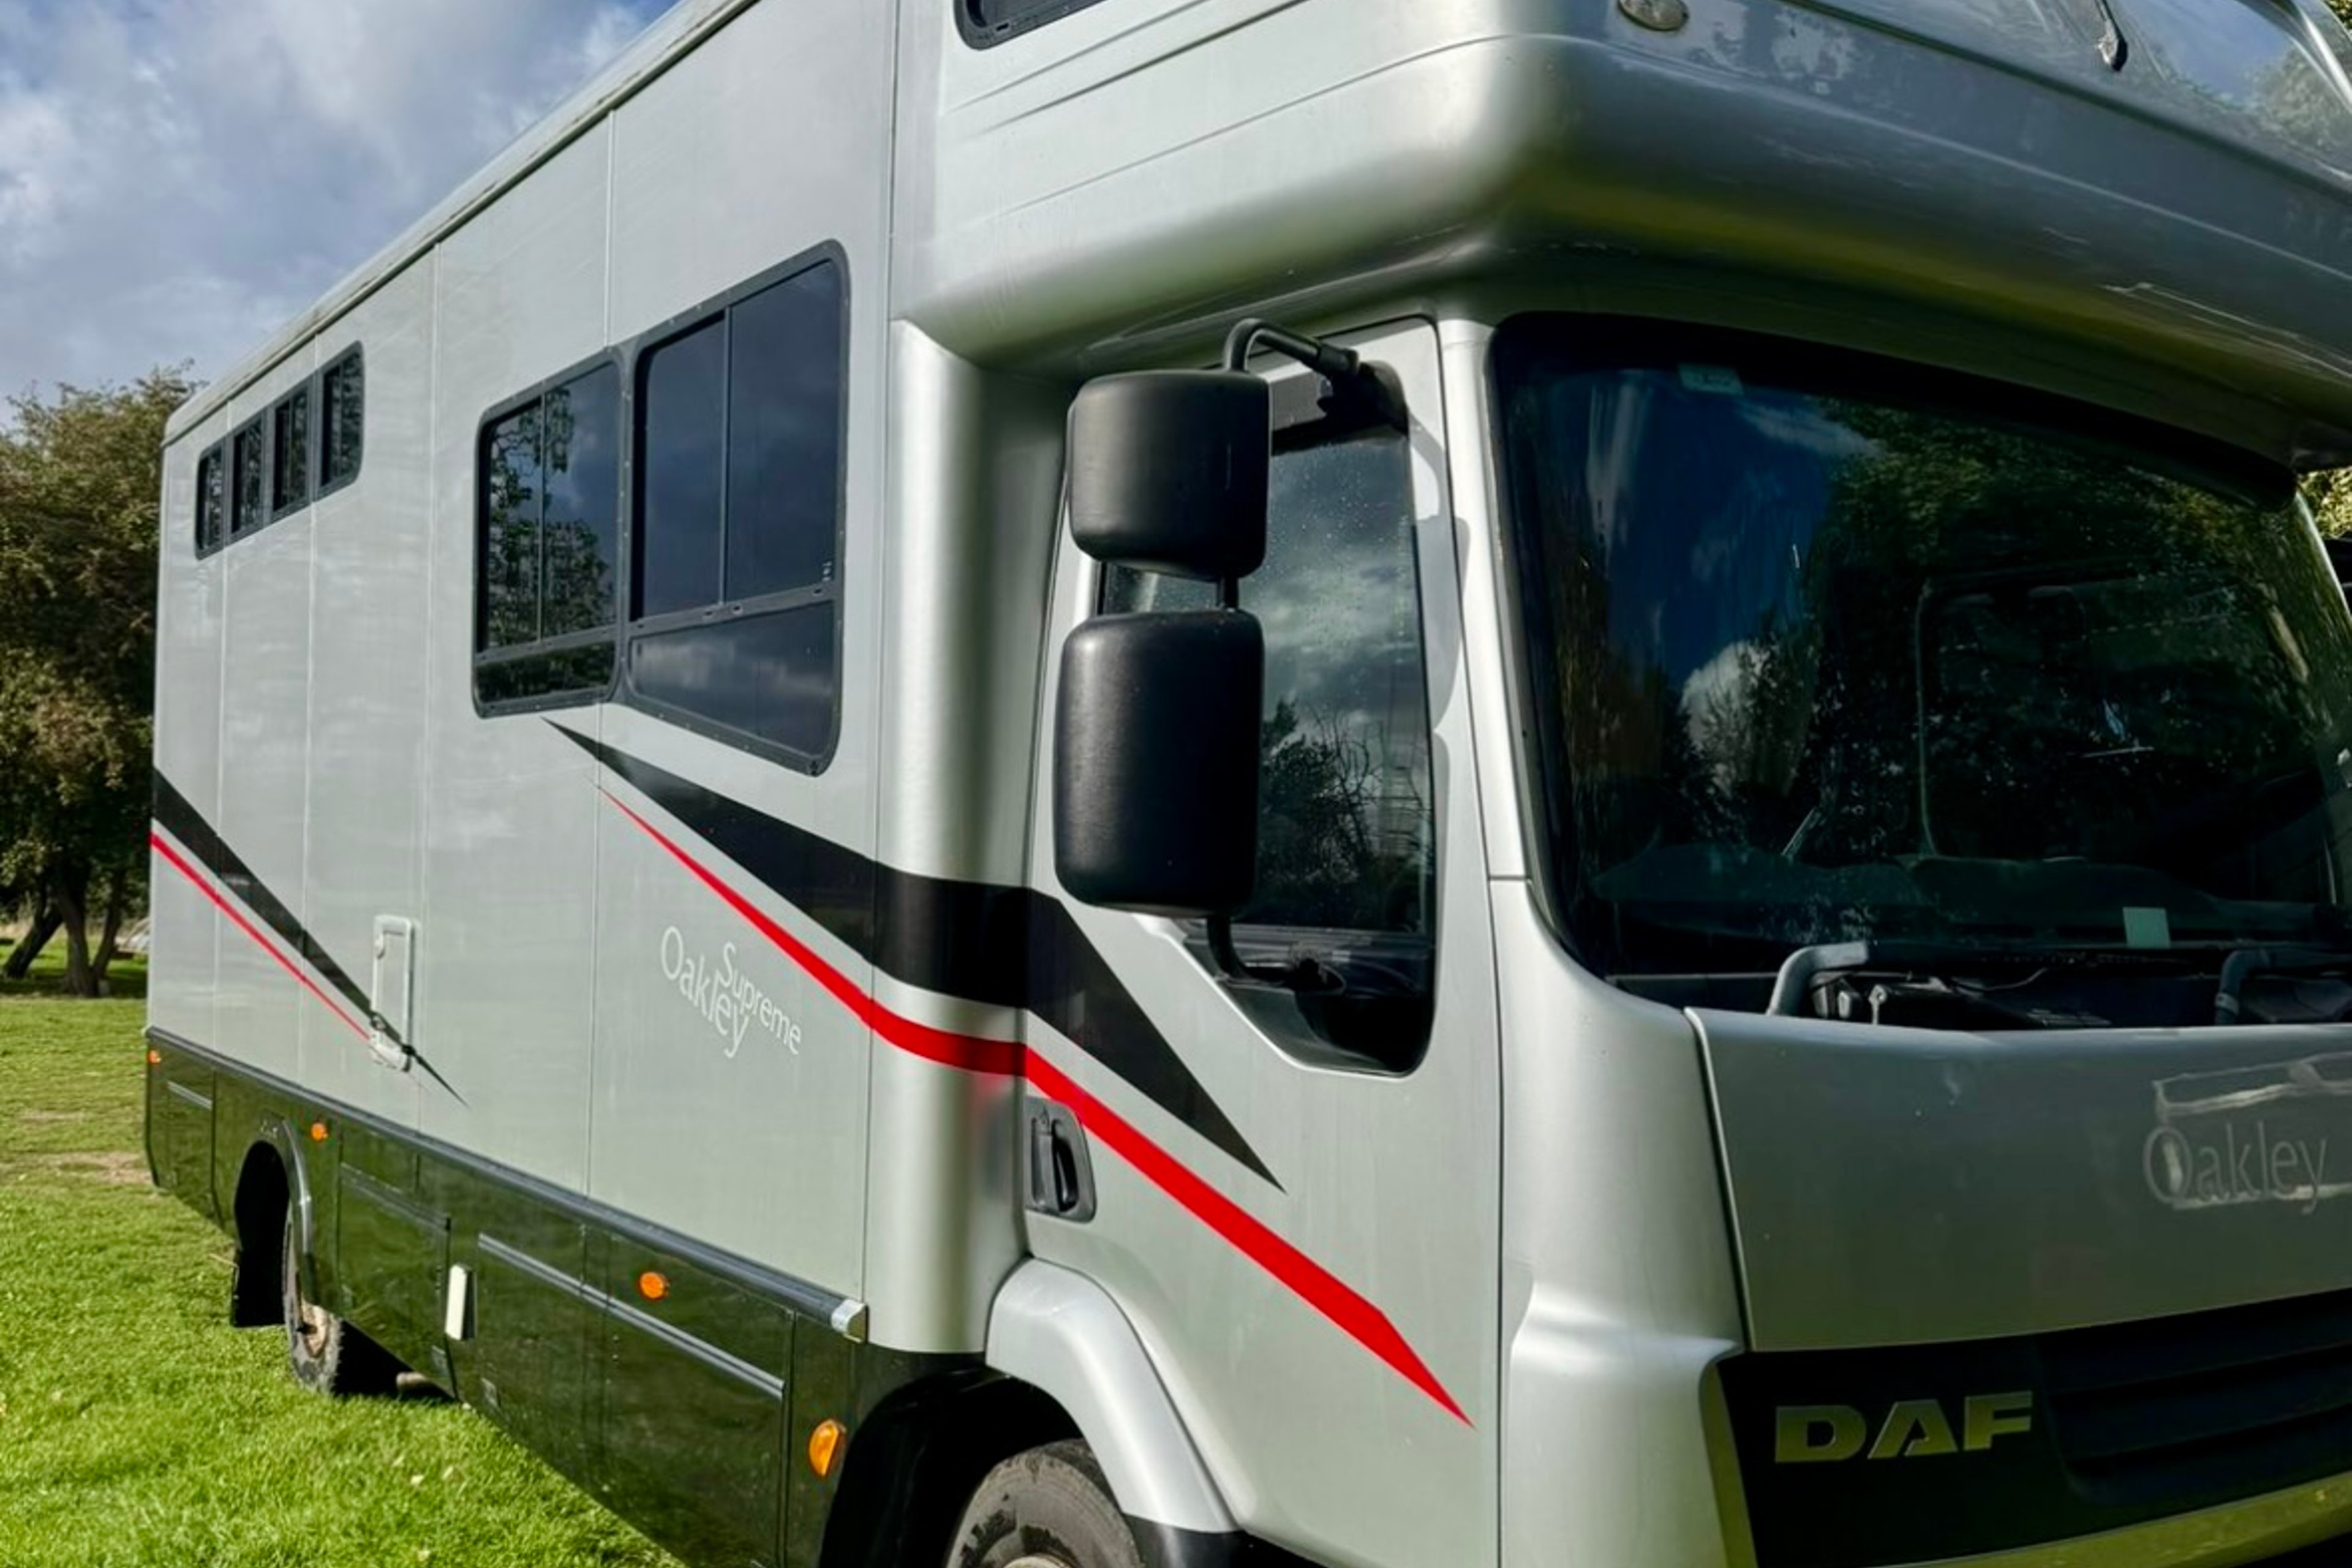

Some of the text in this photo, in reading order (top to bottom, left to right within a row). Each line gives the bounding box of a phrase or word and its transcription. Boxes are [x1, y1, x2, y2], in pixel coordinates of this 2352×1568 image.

[661, 925, 749, 1058] Oakley
[718, 942, 801, 1055] Supreme
[2144, 1120, 2327, 1215] Oakley
[1774, 1390, 2033, 1463] DAF
